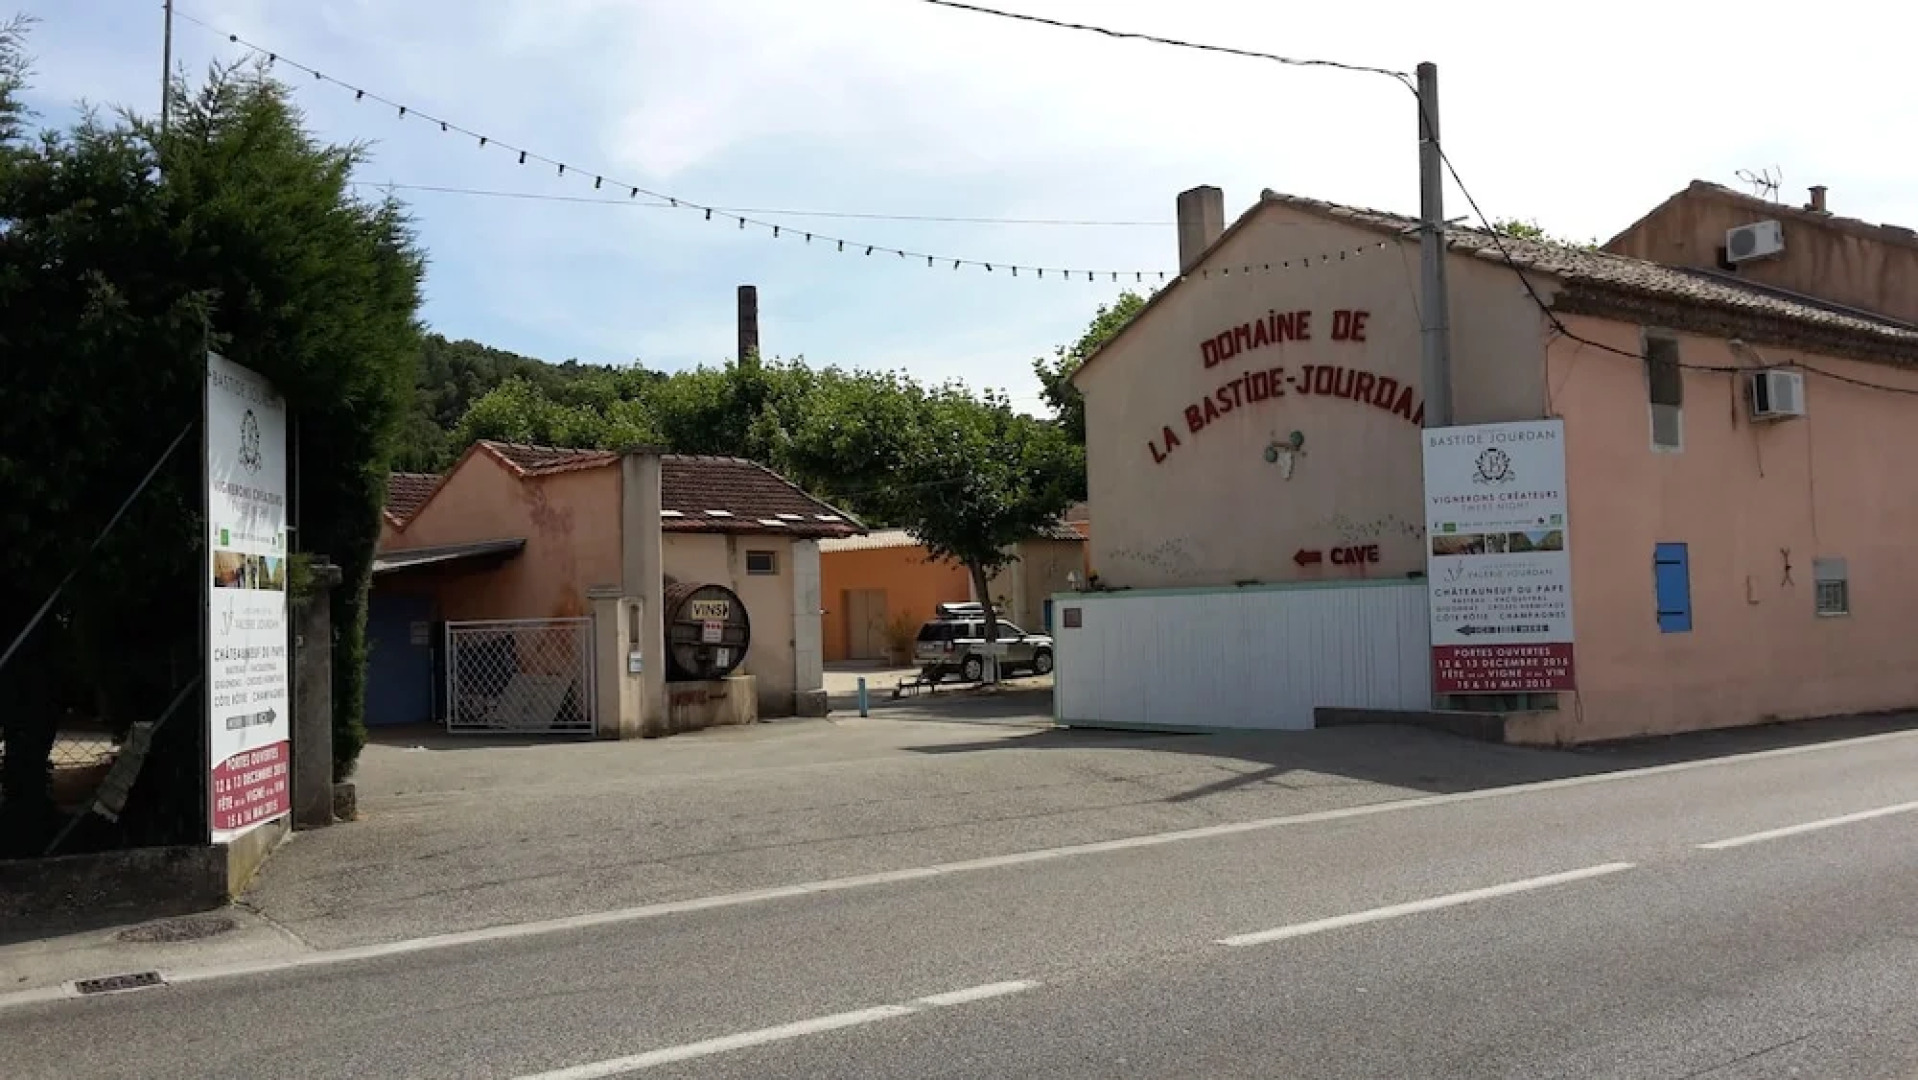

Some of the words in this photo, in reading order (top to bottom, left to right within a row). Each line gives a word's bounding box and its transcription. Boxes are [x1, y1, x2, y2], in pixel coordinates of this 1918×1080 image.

[1331, 310, 1370, 342] DE
[1430, 434, 1482, 447] BASTIDE
[1490, 430, 1556, 444] JOURDAN
[1149, 426, 1181, 464] LA
[1432, 493, 1495, 504] VIGNERONS
[1330, 545, 1379, 565] CAVE
[1537, 584, 1564, 593] PAPE
[693, 603, 721, 617] VINS
[1499, 610, 1566, 620] CHAMPAGNES
[1454, 648, 1493, 657] PORTES
[1497, 647, 1551, 657] OUVERTES
[1487, 668, 1522, 678] VIGNE
[1545, 668, 1566, 676] VIN
[1501, 679, 1521, 688] MAI
